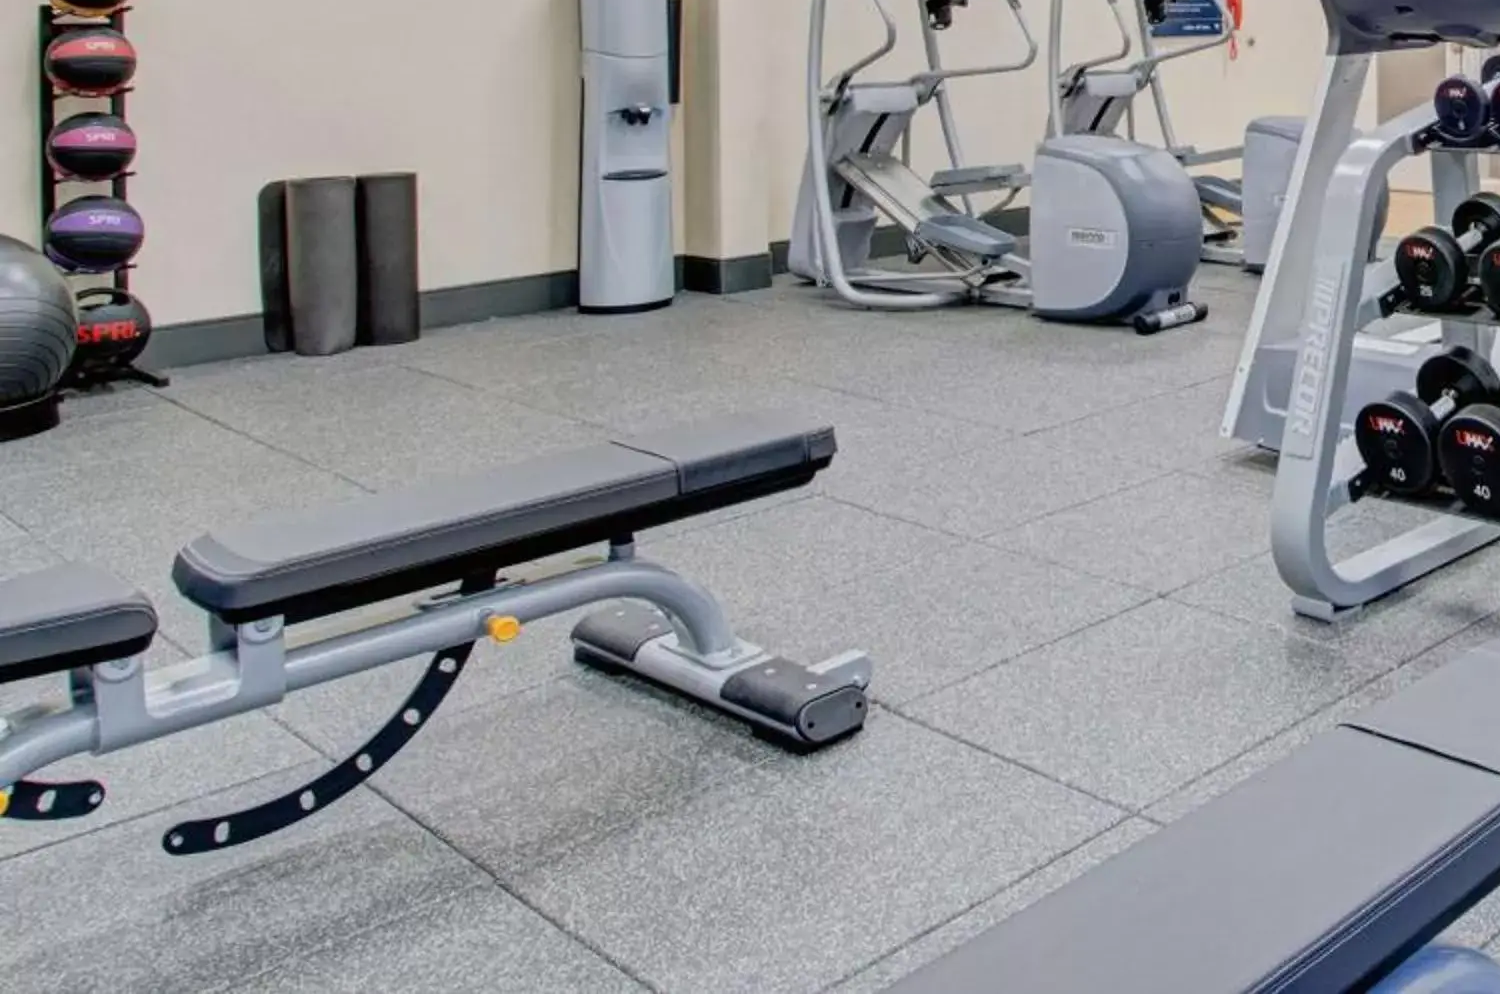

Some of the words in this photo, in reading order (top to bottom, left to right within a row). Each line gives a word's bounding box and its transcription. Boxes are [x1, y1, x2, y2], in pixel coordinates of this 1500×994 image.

[86, 132, 116, 142] SPRI
[88, 214, 121, 225] SPRI
[1405, 245, 1433, 259] UMAX
[76, 322, 134, 343] SPRI
[1370, 415, 1404, 434] UMAX
[1457, 429, 1494, 450] UMAX
[1389, 468, 1406, 481] 40
[1473, 485, 1491, 499] 40
